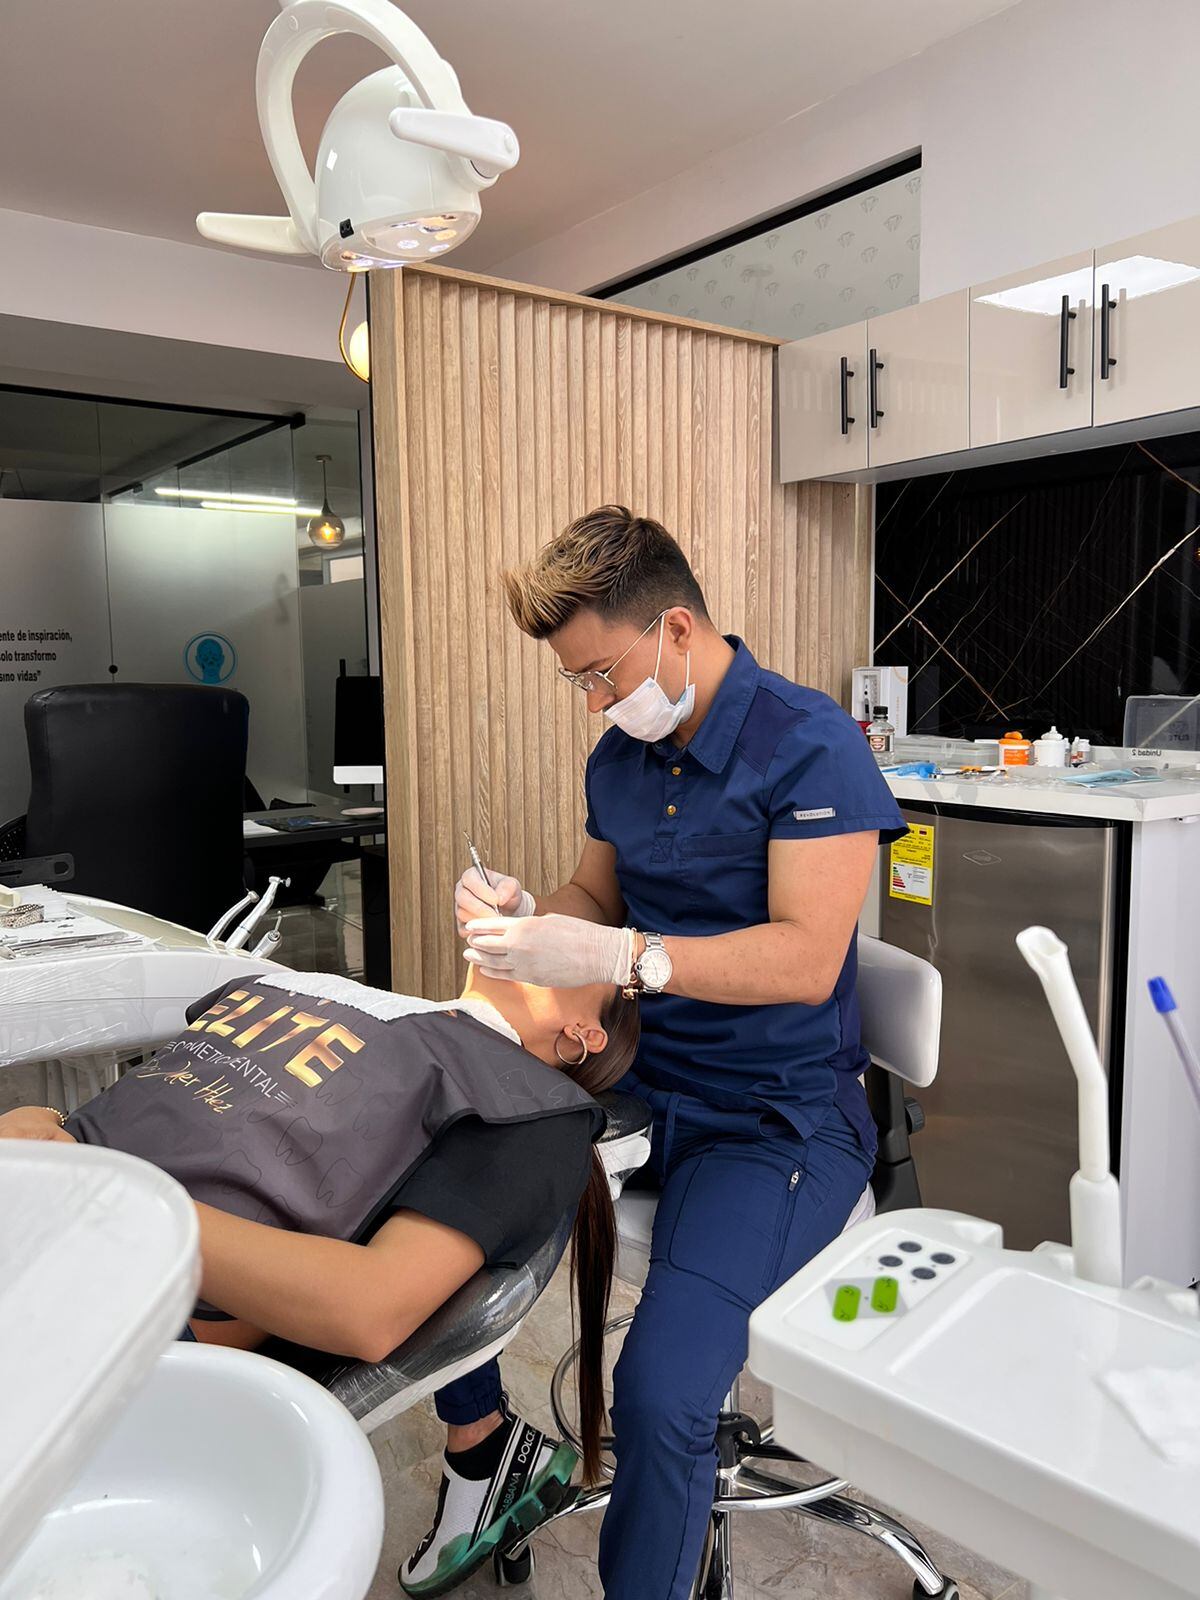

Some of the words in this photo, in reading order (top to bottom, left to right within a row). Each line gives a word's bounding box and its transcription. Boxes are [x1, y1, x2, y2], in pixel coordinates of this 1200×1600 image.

[17, 629, 27, 641] de
[28, 629, 73, 644] inspiración,
[14, 650, 57, 662] transformo
[186, 989, 366, 1089] ELITE
